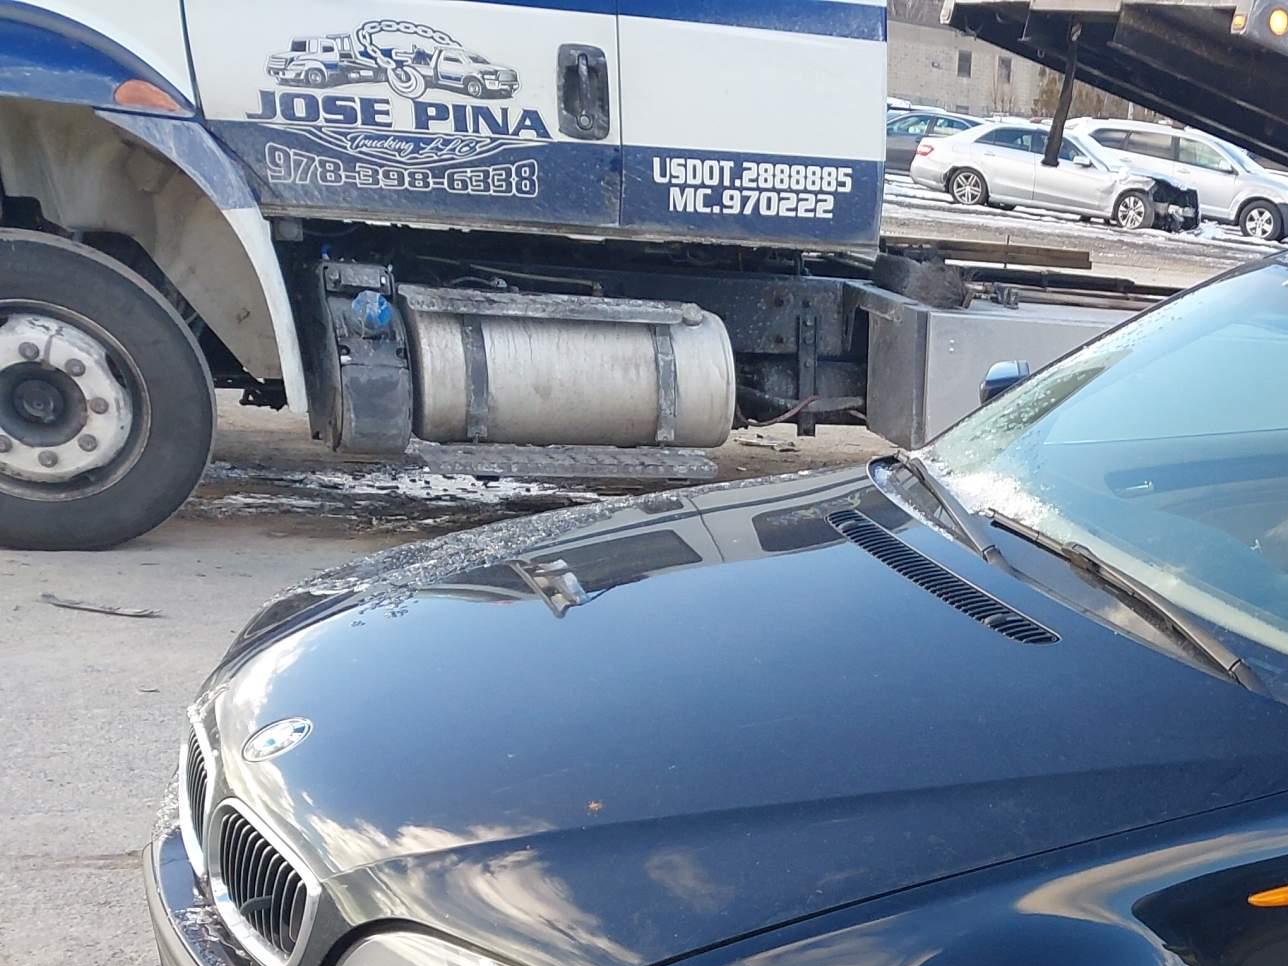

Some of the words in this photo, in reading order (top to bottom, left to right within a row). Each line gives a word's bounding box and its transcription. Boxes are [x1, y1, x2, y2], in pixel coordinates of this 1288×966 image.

[245, 90, 393, 128] JOSE
[413, 100, 550, 139] PINA
[350, 133, 415, 156] Trucking
[419, 137, 476, 156] LLC
[265, 142, 538, 197] 978-398-6338
[653, 157, 853, 192] USDOT.2888885
[669, 187, 834, 218] MC.970222
